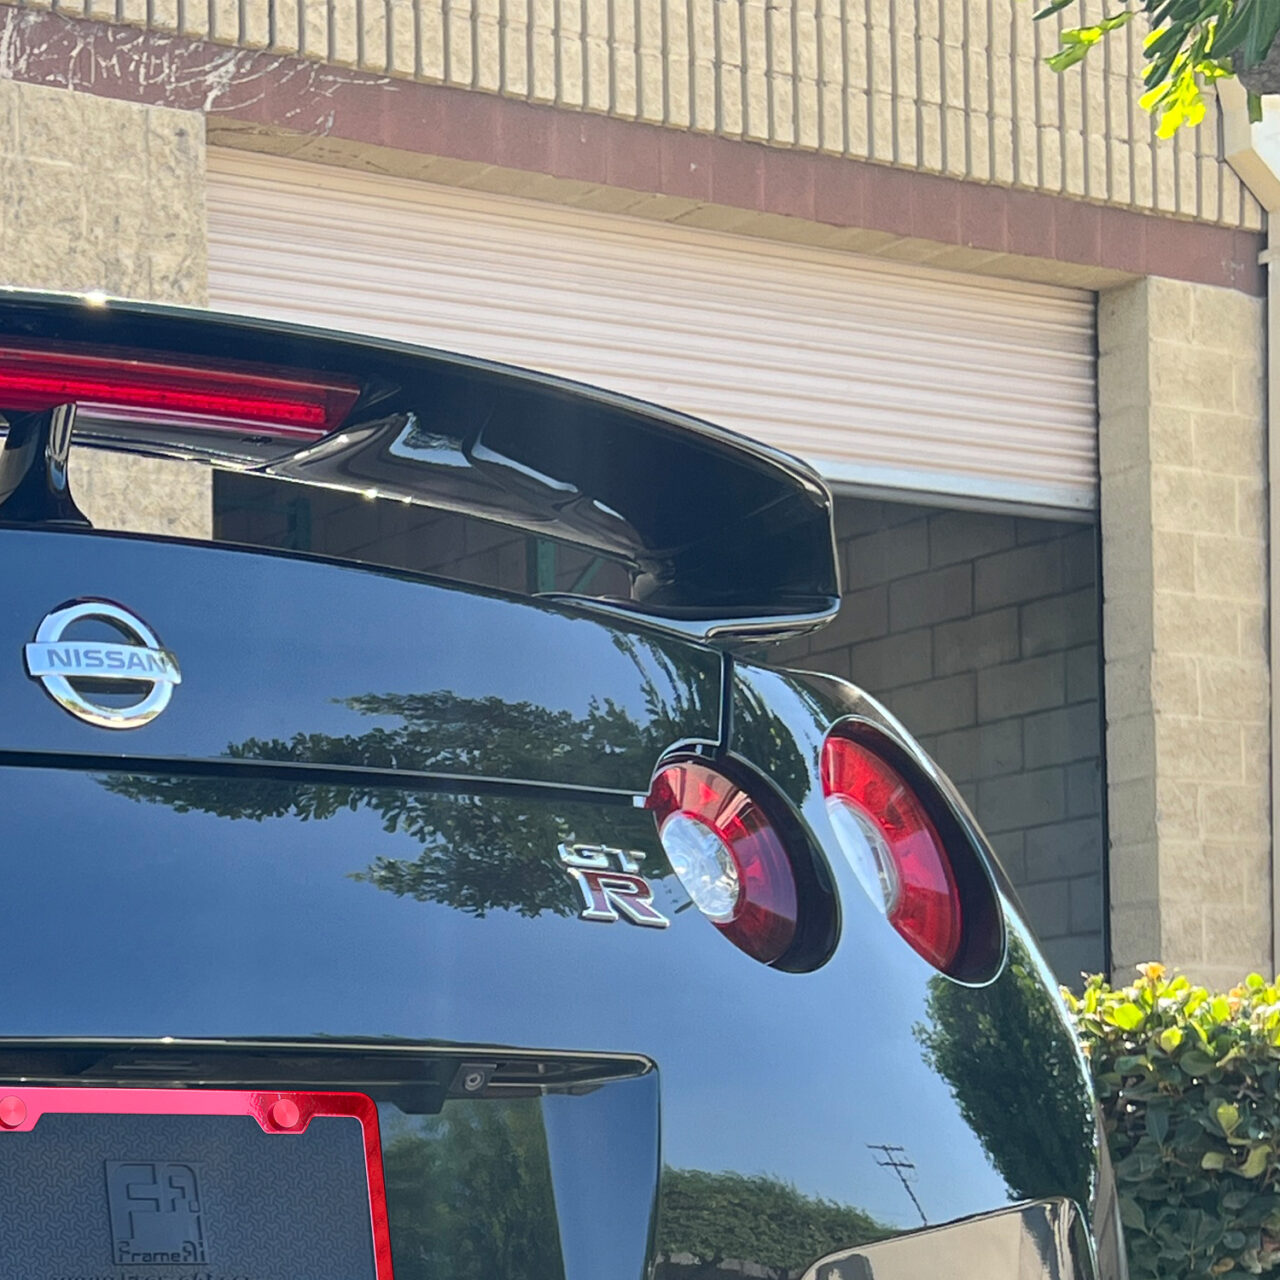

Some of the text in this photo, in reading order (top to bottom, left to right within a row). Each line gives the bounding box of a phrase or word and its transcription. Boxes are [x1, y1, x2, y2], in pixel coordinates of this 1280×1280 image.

[46, 648, 170, 674] NISSAN
[557, 843, 646, 873] GT
[567, 867, 670, 927] R
